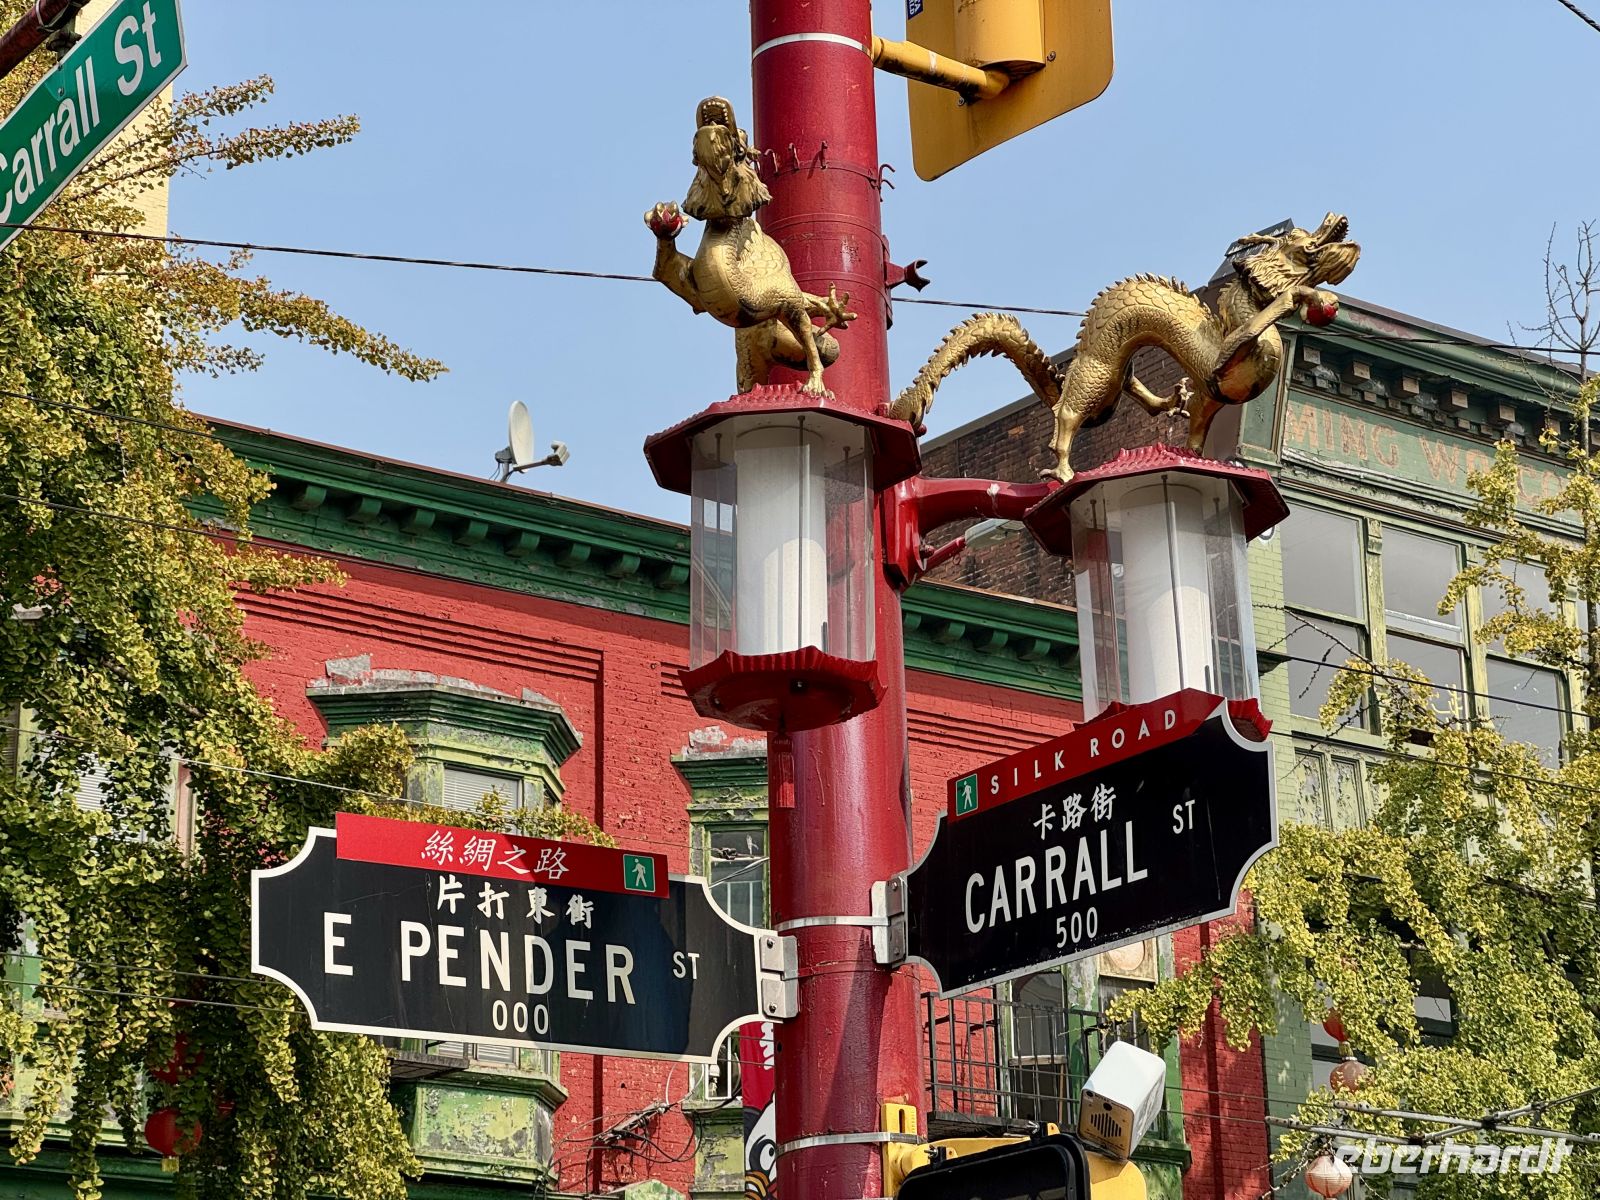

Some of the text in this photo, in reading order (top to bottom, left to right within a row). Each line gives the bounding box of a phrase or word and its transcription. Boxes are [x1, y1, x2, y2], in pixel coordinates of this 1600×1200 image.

[114, 1, 162, 96] St
[1284, 401, 1399, 470] MING
[990, 709, 1176, 795] SILK ROAD
[1033, 783, 1117, 841] 卡路街
[420, 830, 570, 880] 絲綢之路
[965, 799, 1196, 934] CARRALL ST
[436, 873, 594, 929] 片打東街
[1056, 906, 1098, 948] 500
[323, 911, 700, 1005] E PENDER ST
[492, 999, 549, 1035] 000
